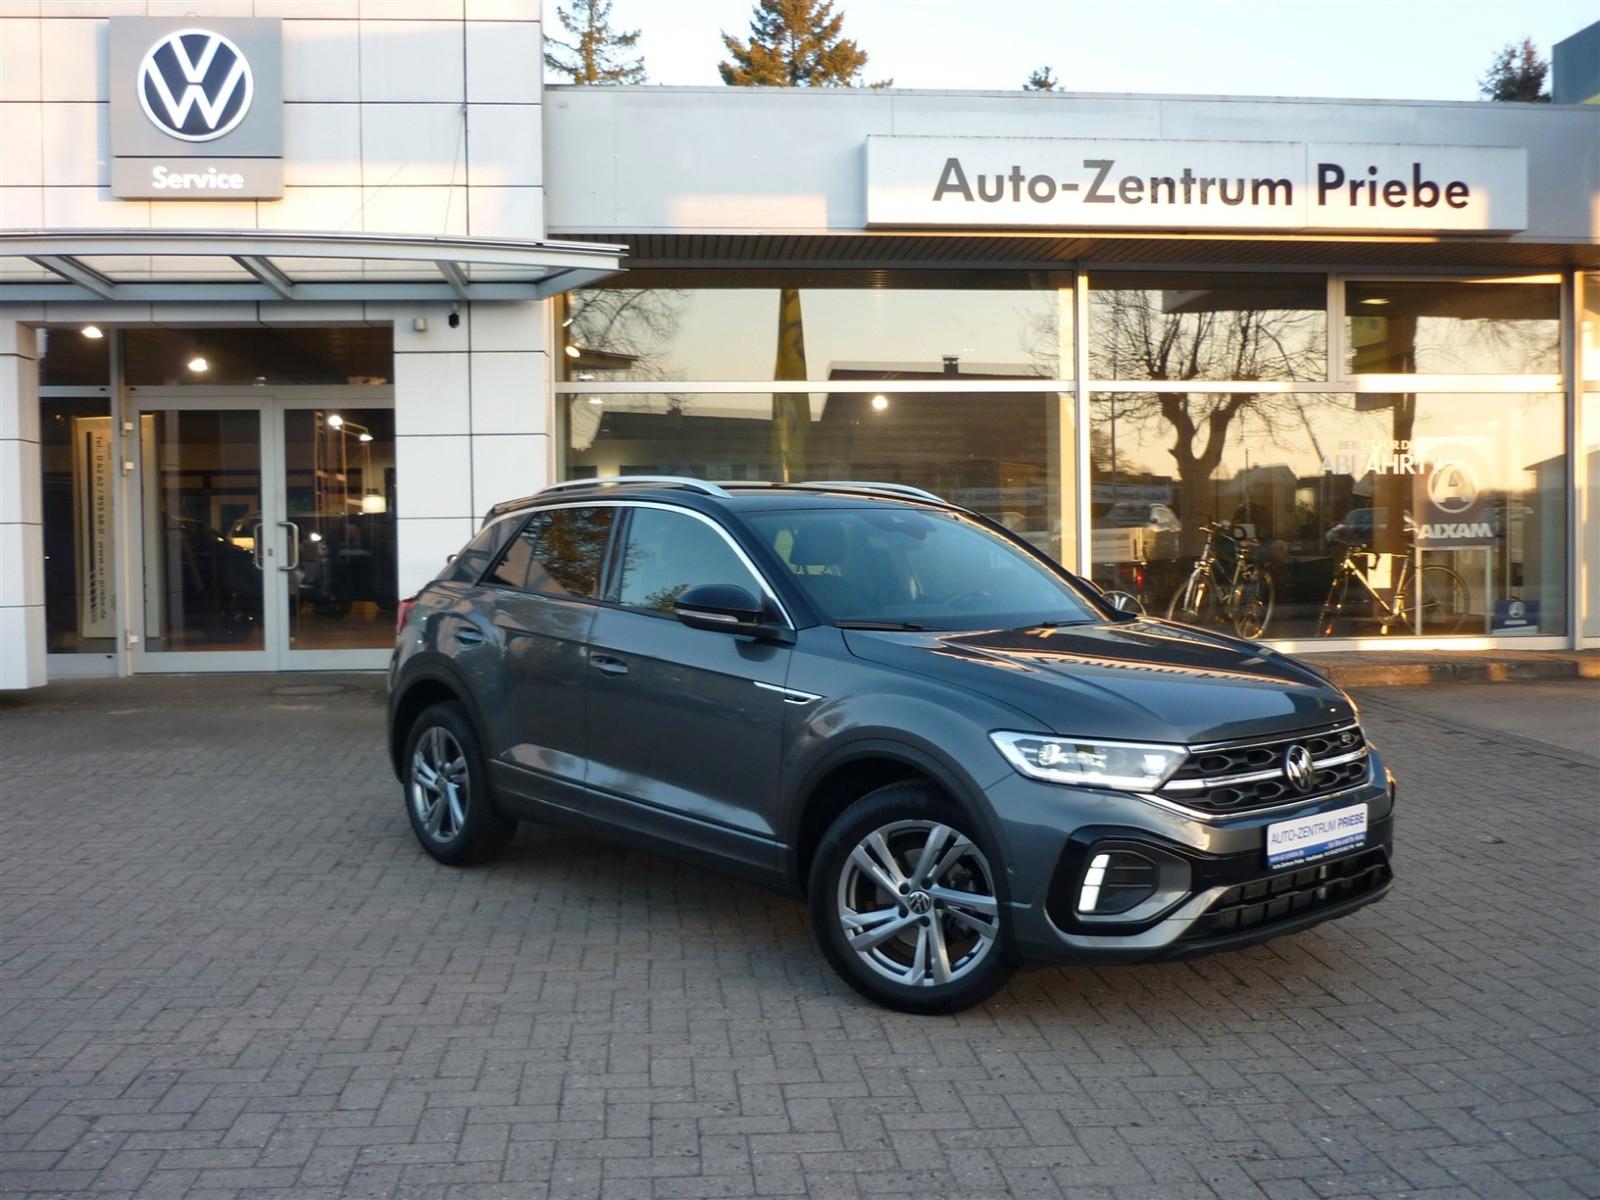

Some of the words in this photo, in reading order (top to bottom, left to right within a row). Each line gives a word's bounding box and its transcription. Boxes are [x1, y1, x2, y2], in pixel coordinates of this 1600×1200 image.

[151, 165, 245, 190] Service
[931, 156, 1293, 206] Auto-Zentrum
[1316, 162, 1470, 209] Priebe
[1417, 522, 1493, 539] AIXAM
[1271, 819, 1337, 845] AUTO-ZENTRUM
[1337, 812, 1365, 830] PRIEBE
